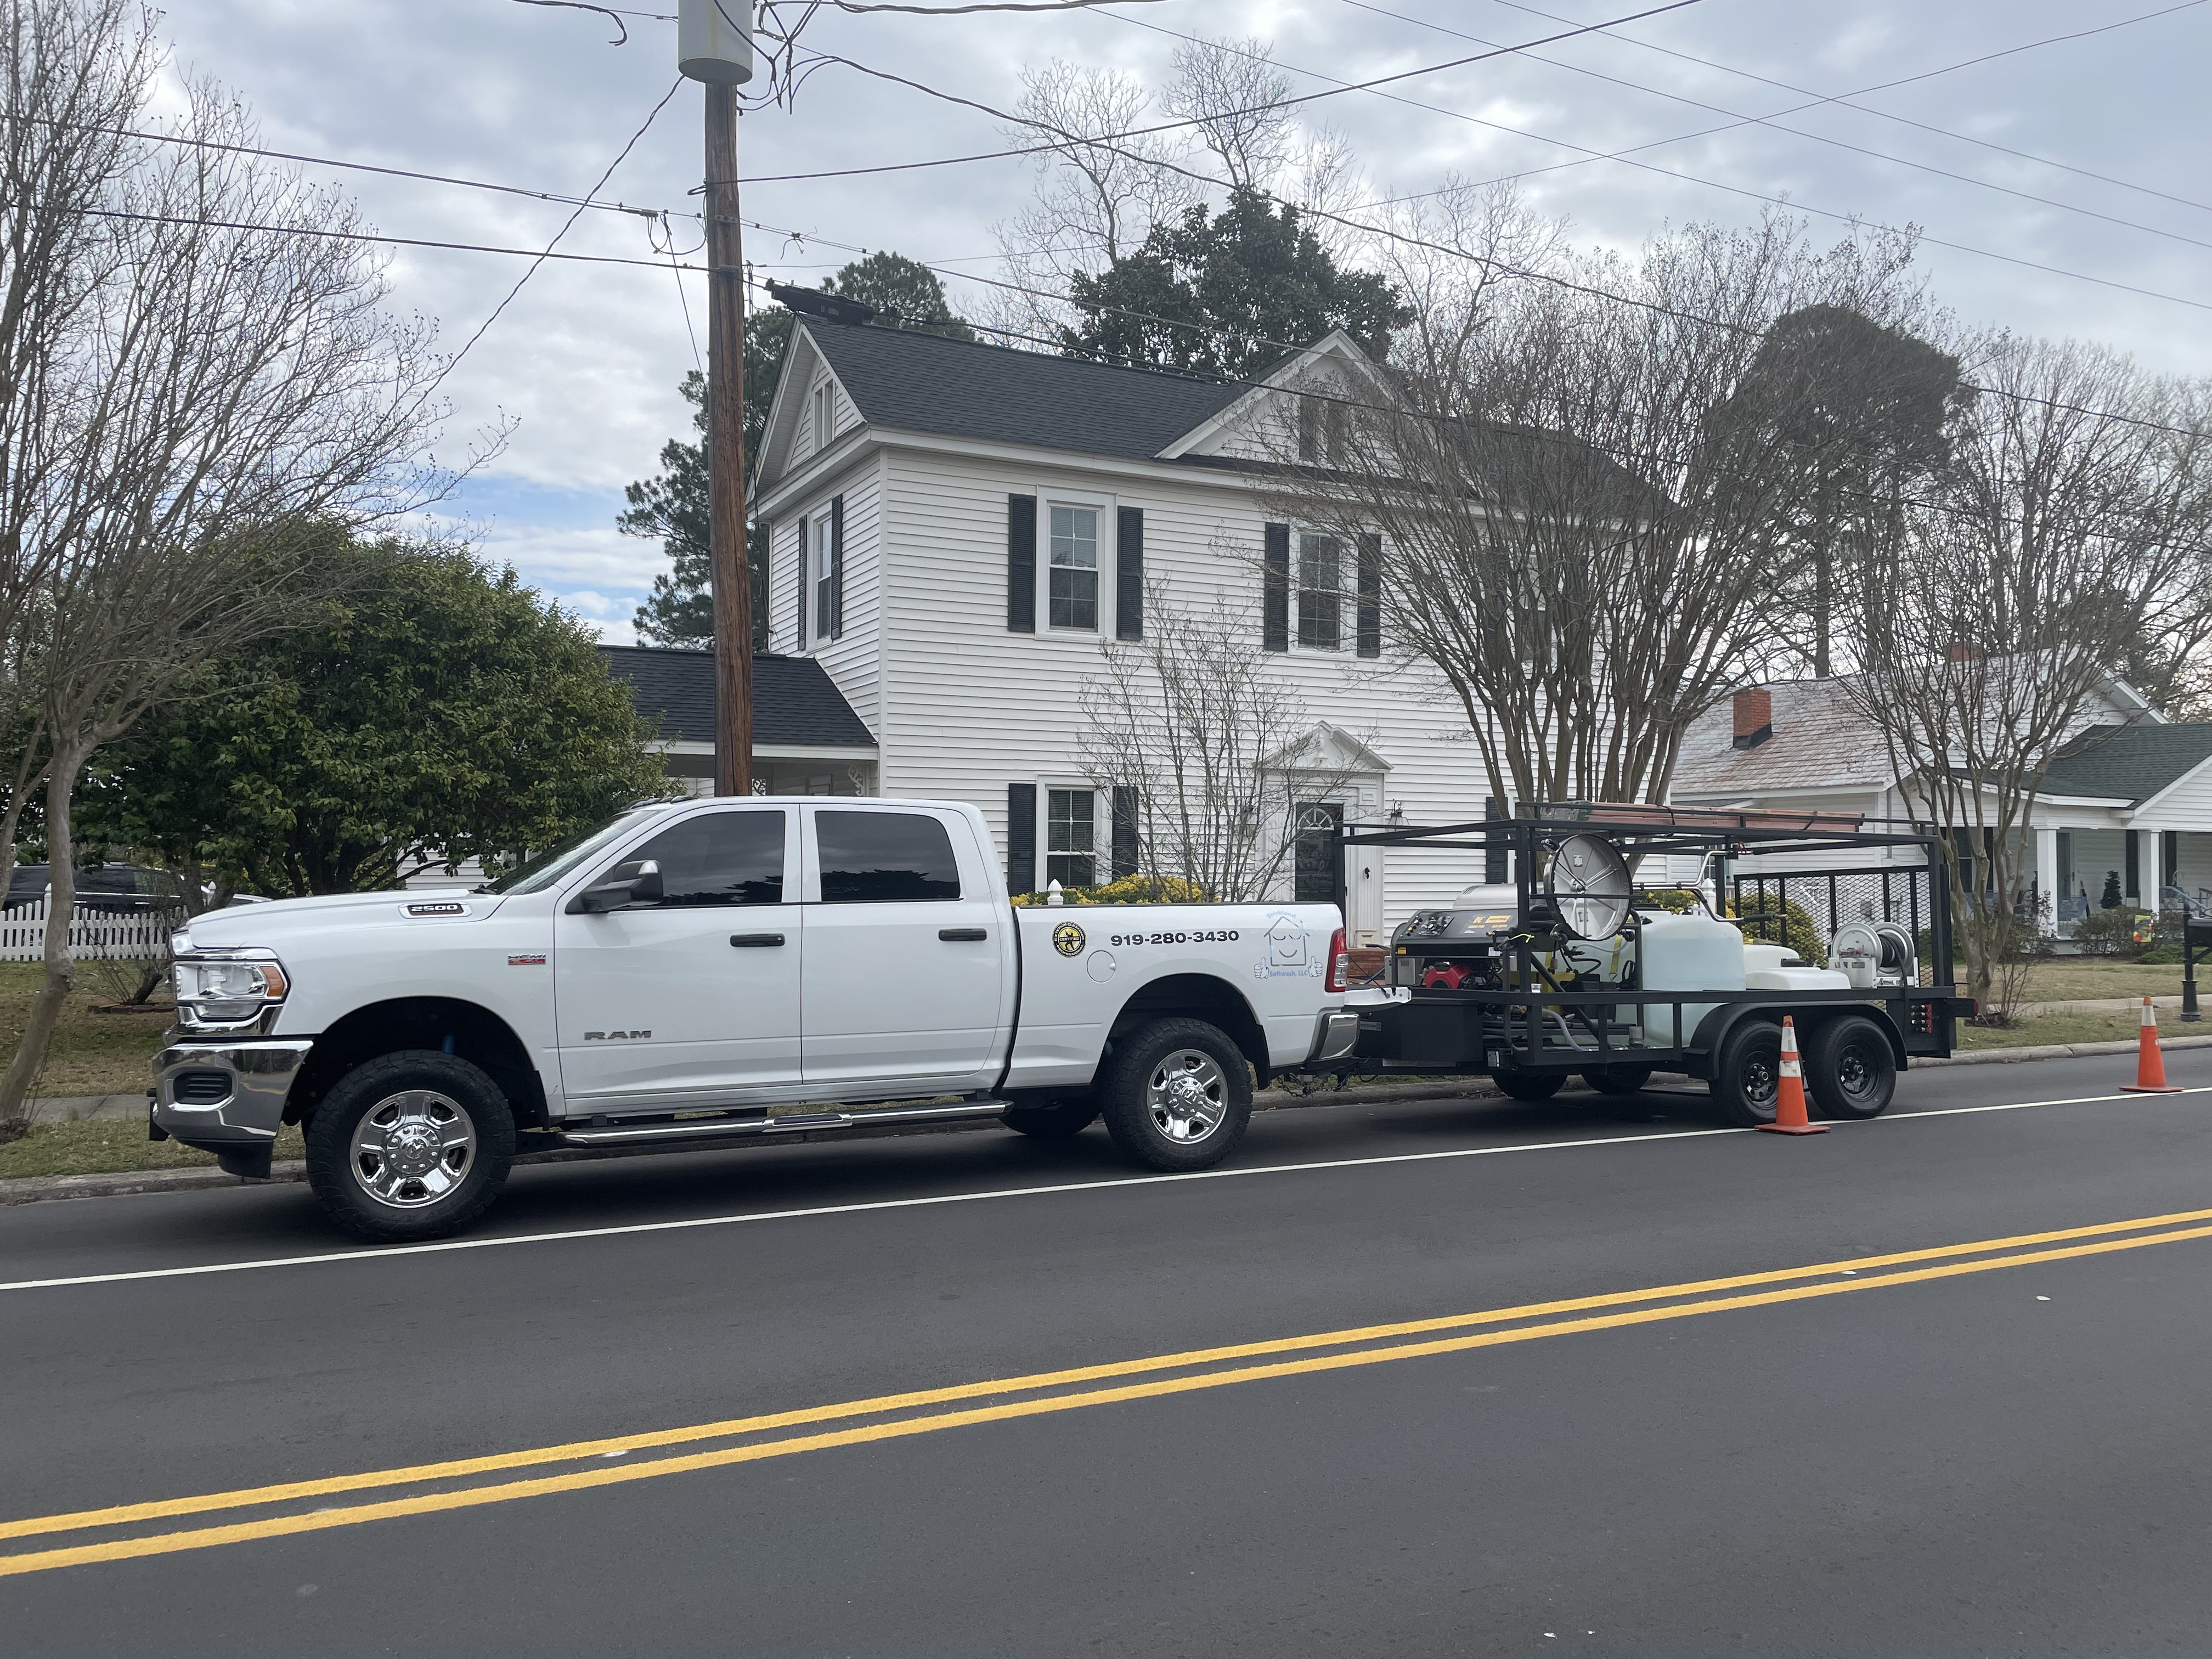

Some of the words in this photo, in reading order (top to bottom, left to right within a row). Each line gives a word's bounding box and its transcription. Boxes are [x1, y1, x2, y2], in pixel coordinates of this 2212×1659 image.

[1266, 911, 1296, 919] Strickland
[1054, 923, 1067, 941] EXTERIOR
[1067, 923, 1085, 940] CLEANING
[1110, 930, 1239, 946] 919-280-3430
[1056, 944, 1084, 956] PROFESSIONAL
[584, 1030, 652, 1040] RAM
